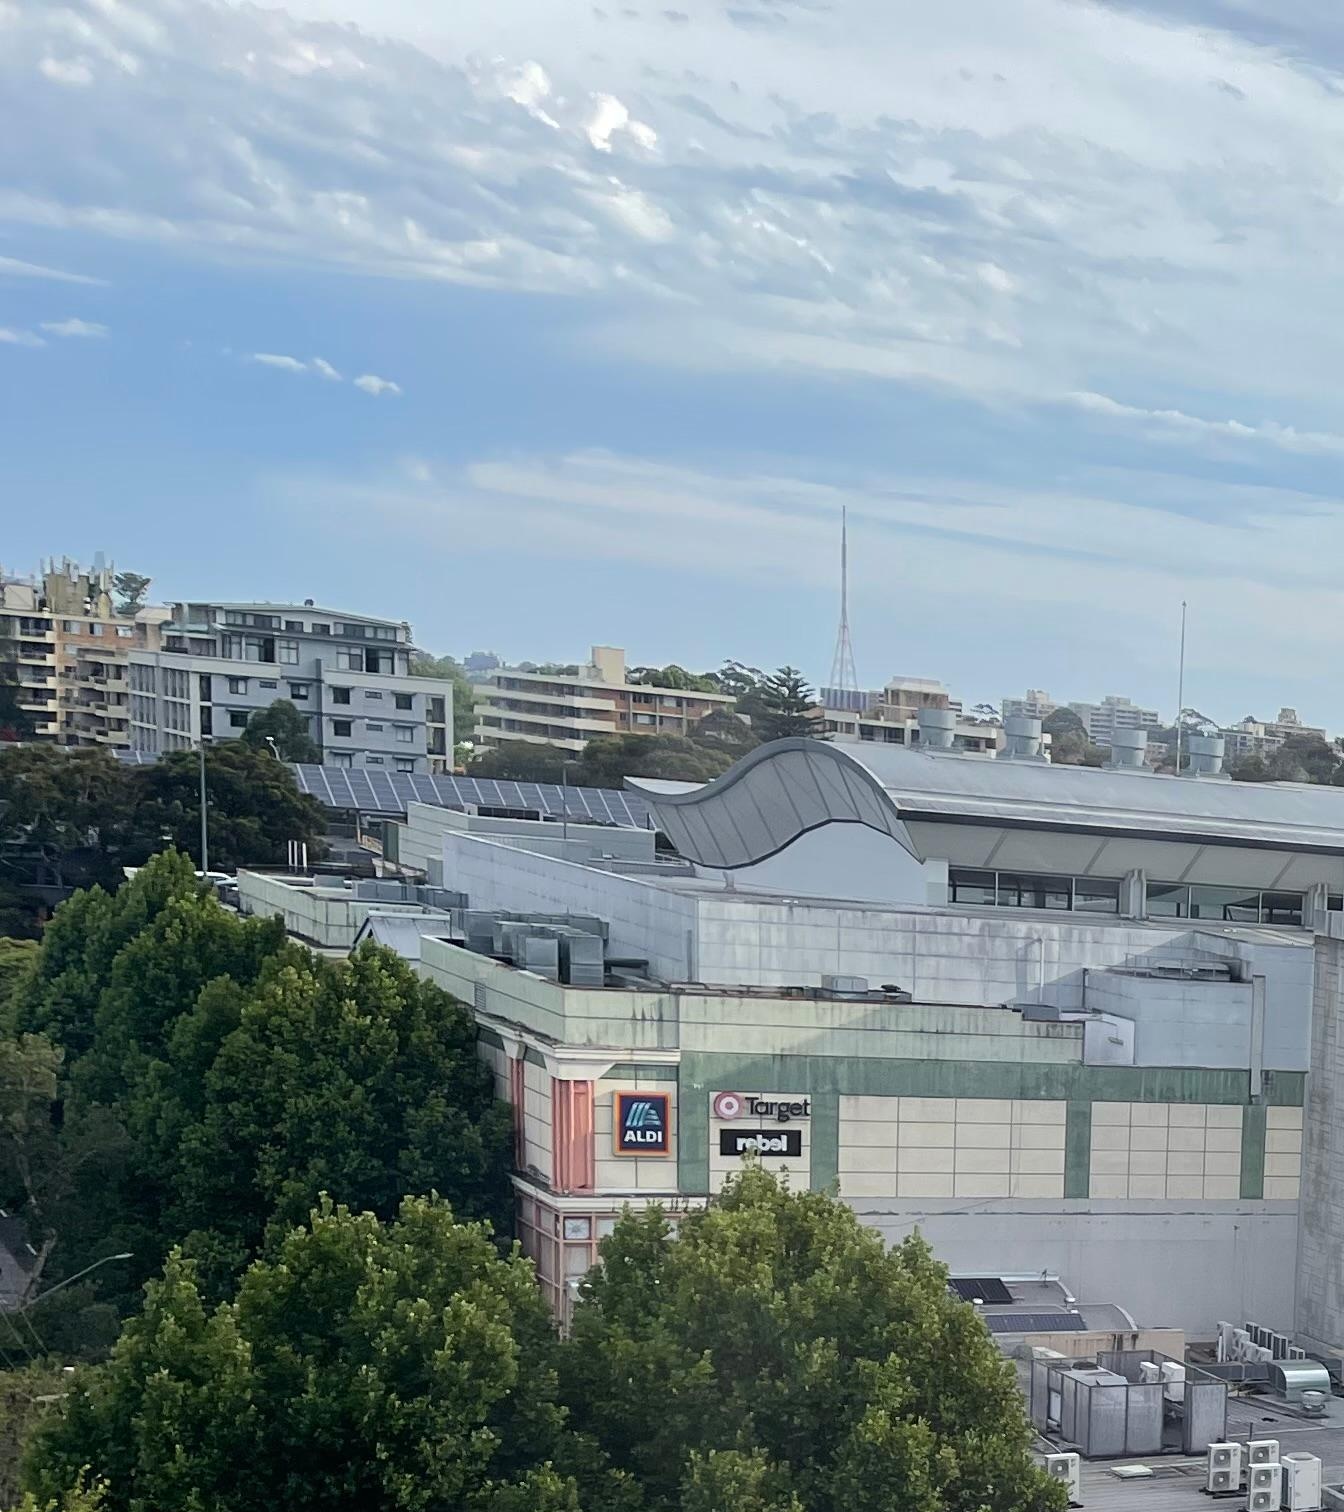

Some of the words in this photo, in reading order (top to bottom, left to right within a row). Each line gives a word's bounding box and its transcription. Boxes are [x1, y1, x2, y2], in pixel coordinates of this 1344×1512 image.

[745, 1097, 811, 1122] Target
[623, 1129, 663, 1143] ALDI
[736, 1134, 788, 1152] rebel
